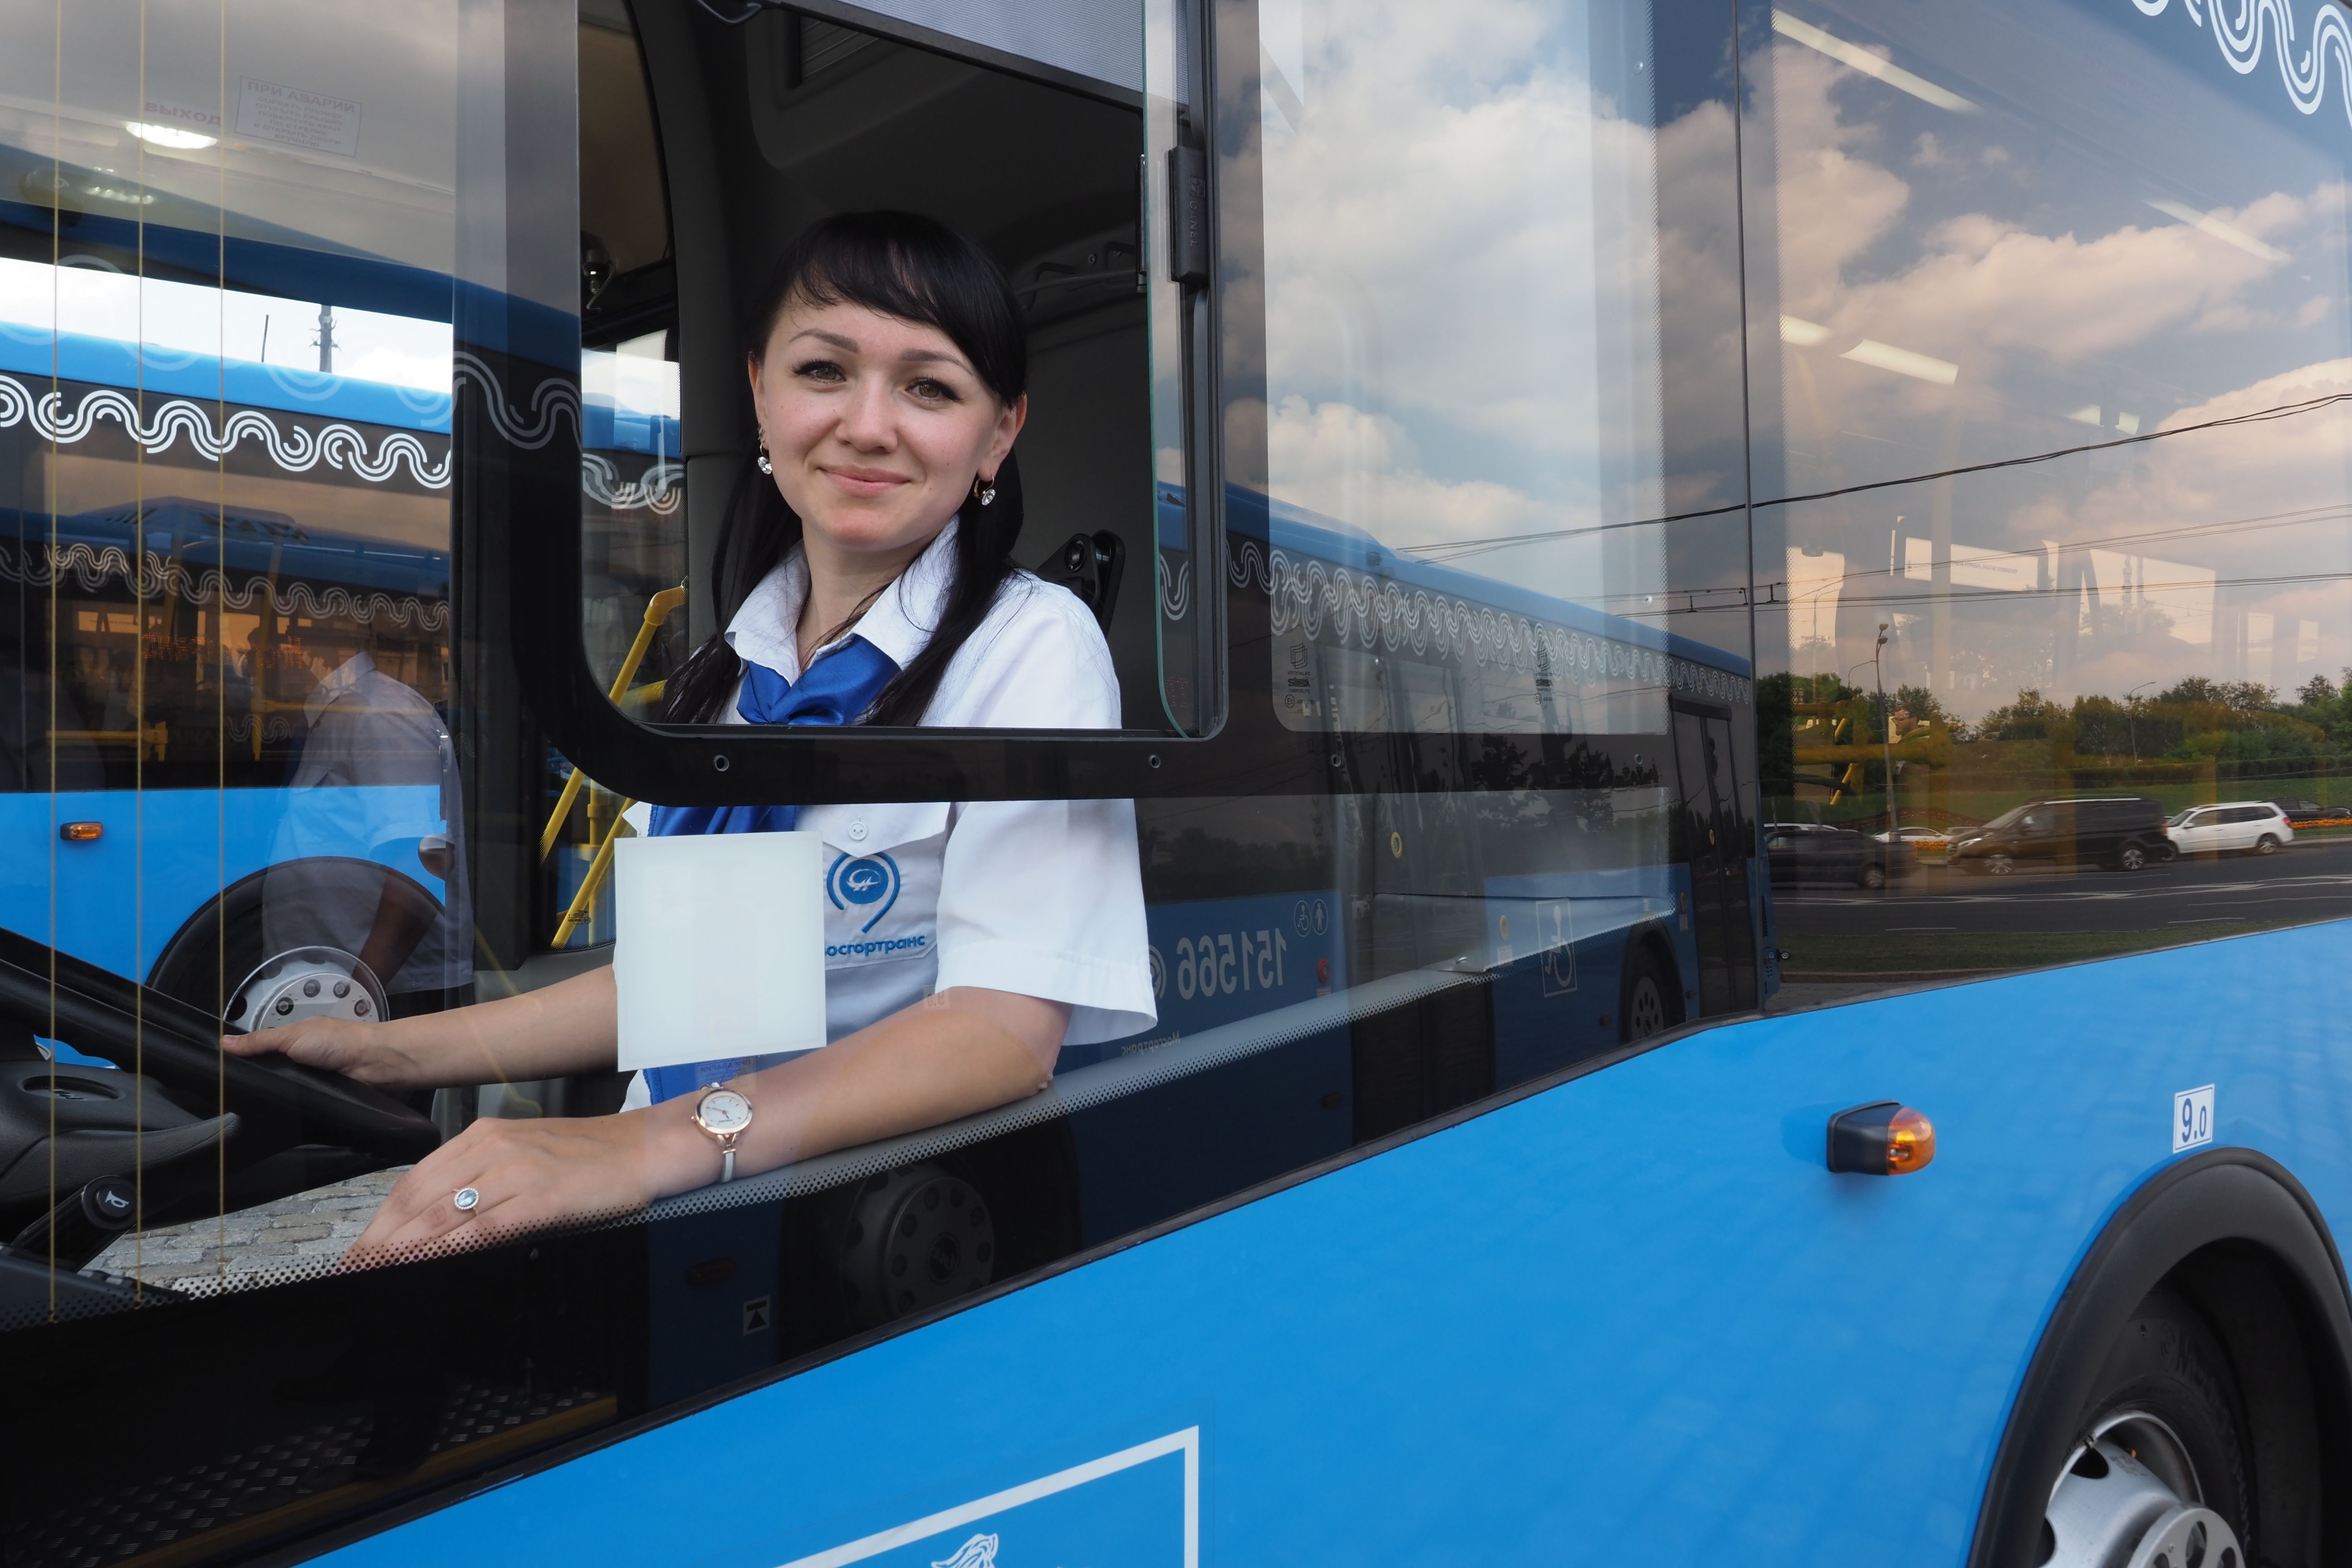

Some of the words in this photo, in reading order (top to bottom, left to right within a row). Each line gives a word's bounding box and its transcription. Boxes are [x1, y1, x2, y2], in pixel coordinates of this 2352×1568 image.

[248, 81, 282, 97] ПРИ
[287, 91, 355, 113] АВАРИИ
[258, 96, 302, 110] СОРВАТЬ
[145, 102, 221, 127] ВЫХОД
[255, 103, 301, 117] ОТКРЫТЬ
[258, 110, 314, 127] ПОВЕРНУТЬ
[263, 124, 308, 138] ОТКРЫТЬ
[1189, 201, 1199, 247] CANEL
[825, 935, 926, 956] осгортранс
[2181, 1098, 2207, 1143] 9.0
